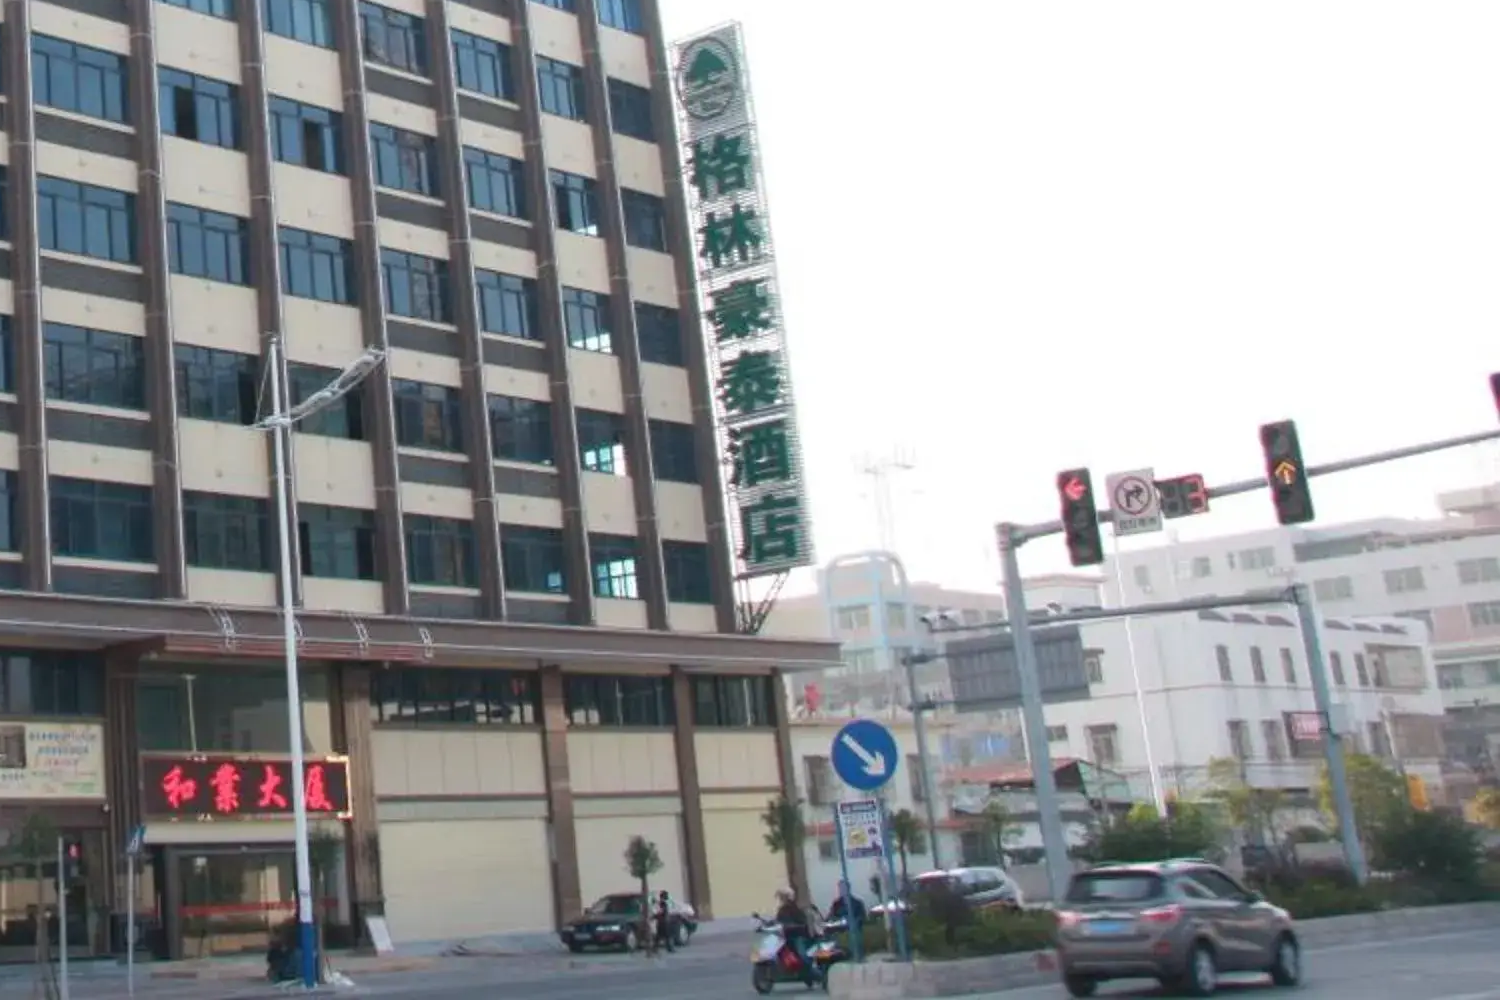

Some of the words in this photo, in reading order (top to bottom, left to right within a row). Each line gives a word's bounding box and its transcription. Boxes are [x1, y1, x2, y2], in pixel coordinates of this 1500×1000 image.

[688, 135, 800, 564] 格林豪泰酒店
